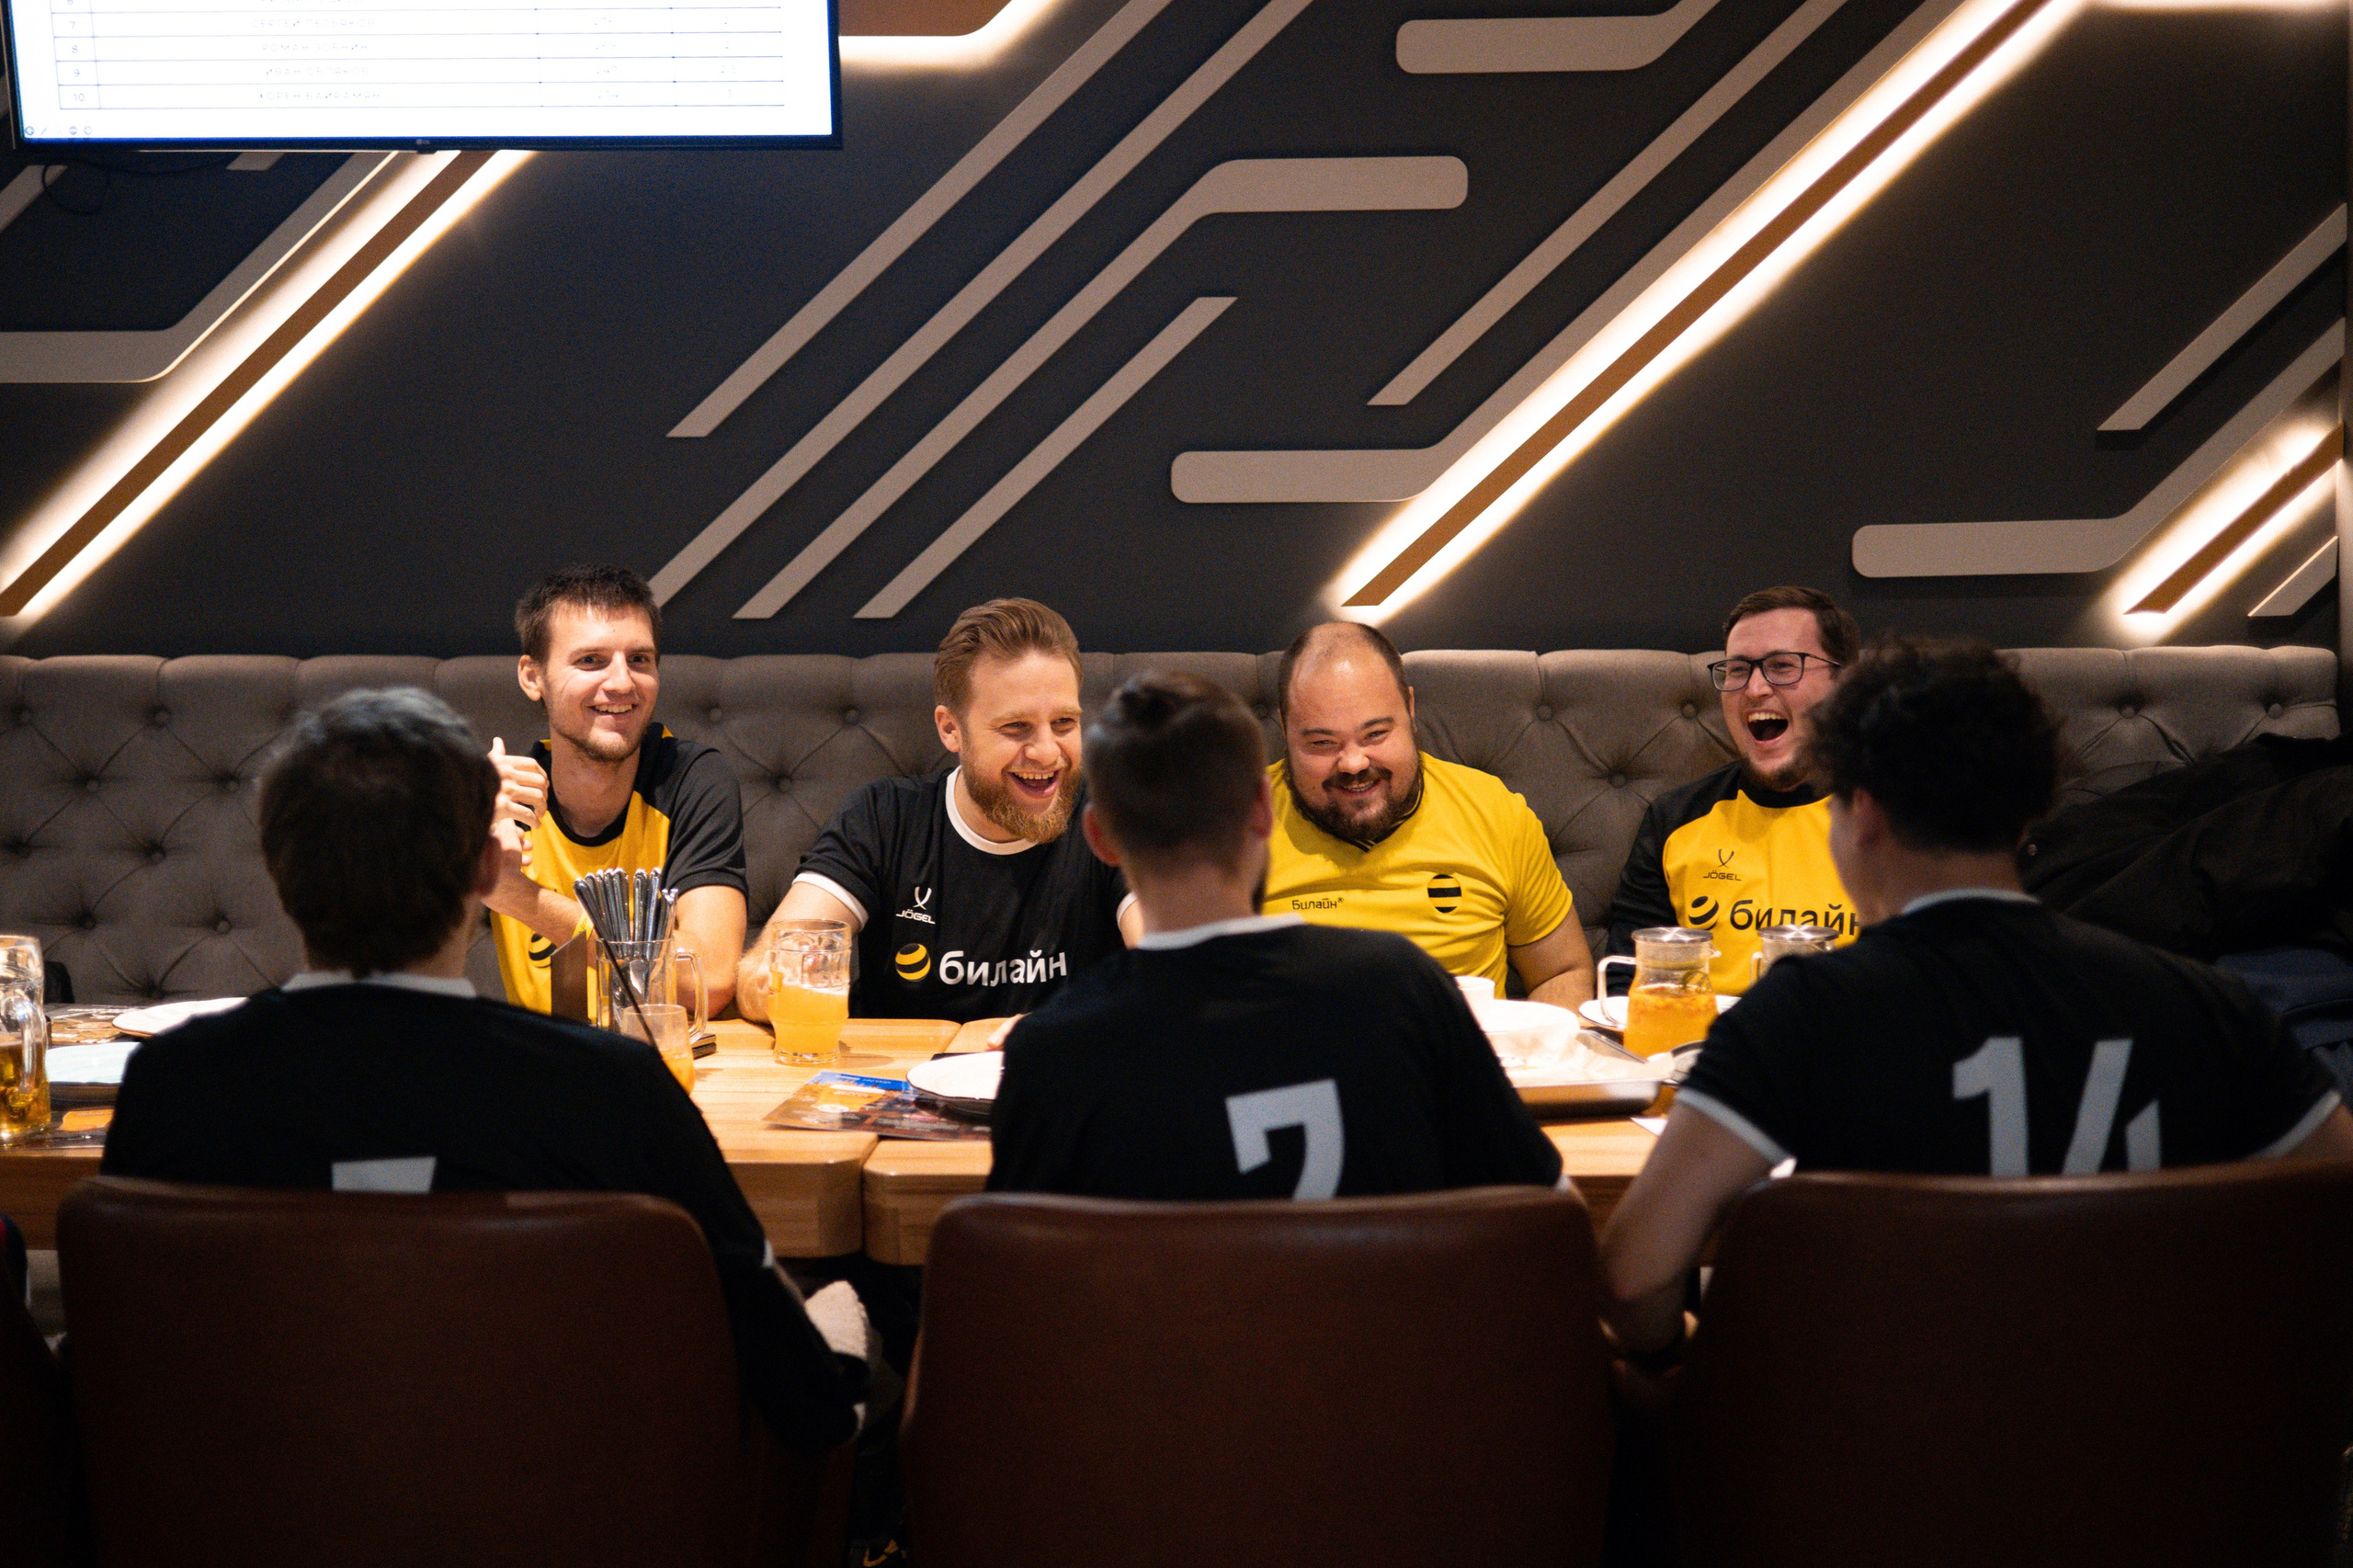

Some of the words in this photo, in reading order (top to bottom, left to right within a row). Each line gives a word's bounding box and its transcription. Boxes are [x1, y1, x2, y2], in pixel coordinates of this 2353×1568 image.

[1702, 869, 1742, 881] JÖGEL
[895, 909, 936, 925] JÖGEL
[938, 949, 1067, 987] билайн
